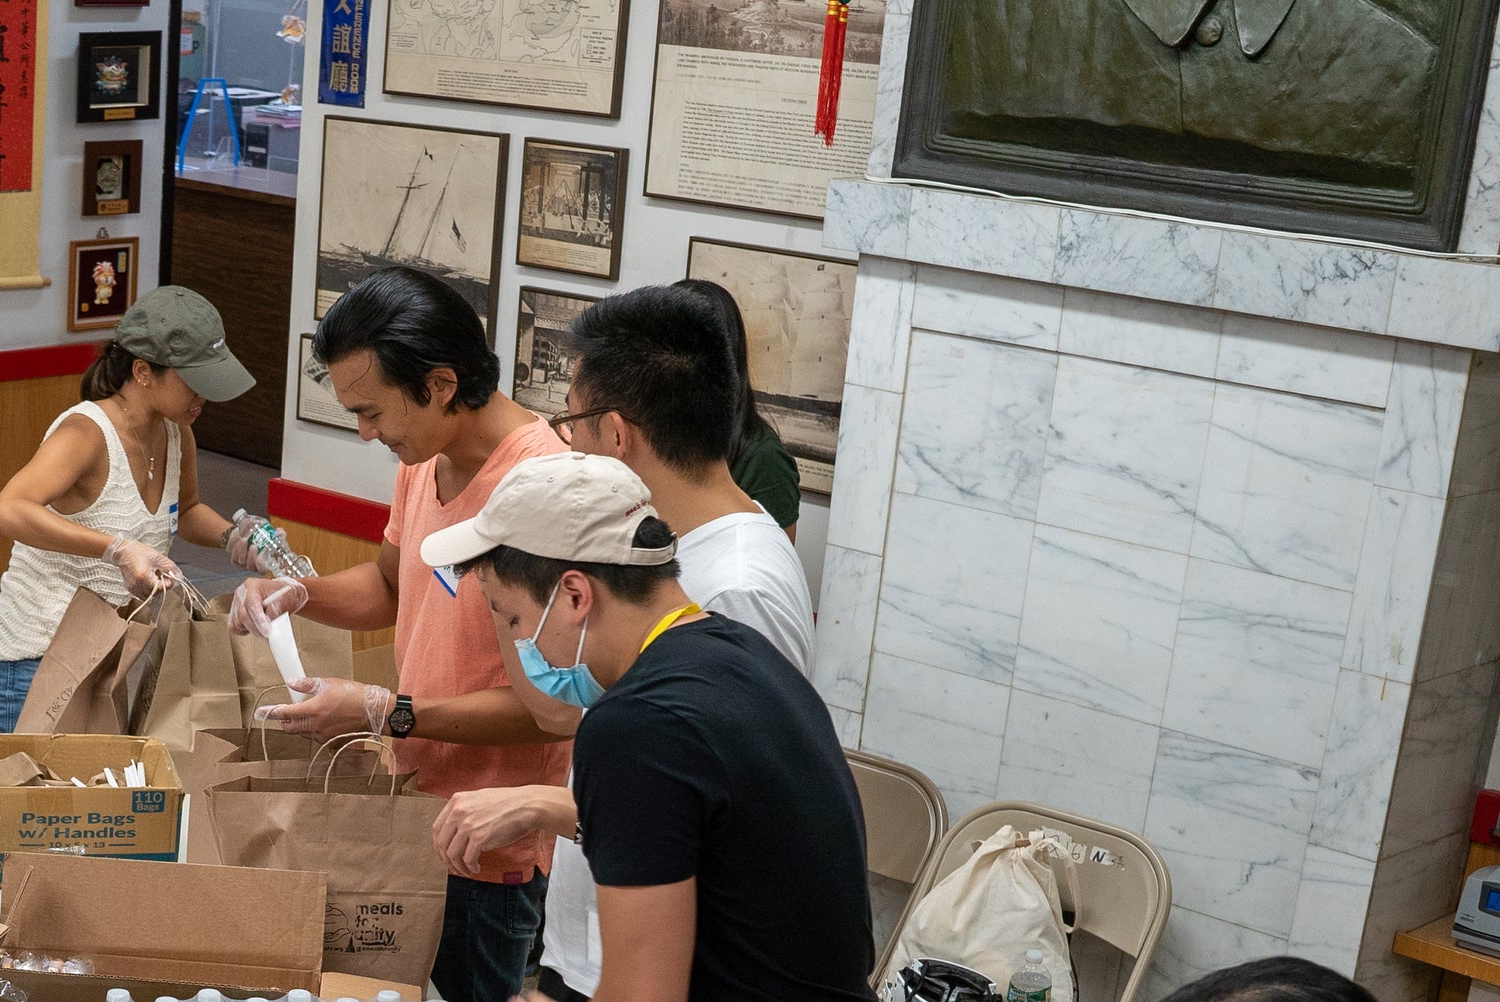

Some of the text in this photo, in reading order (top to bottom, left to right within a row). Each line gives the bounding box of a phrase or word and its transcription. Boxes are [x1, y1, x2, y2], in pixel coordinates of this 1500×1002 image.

[349, 63, 360, 95] ROOM
[134, 792, 163, 803] 110
[136, 803, 160, 812] Bags
[22, 813, 136, 826] Paper Bags
[19, 827, 136, 839] w/ Handles
[356, 902, 404, 916] meals
